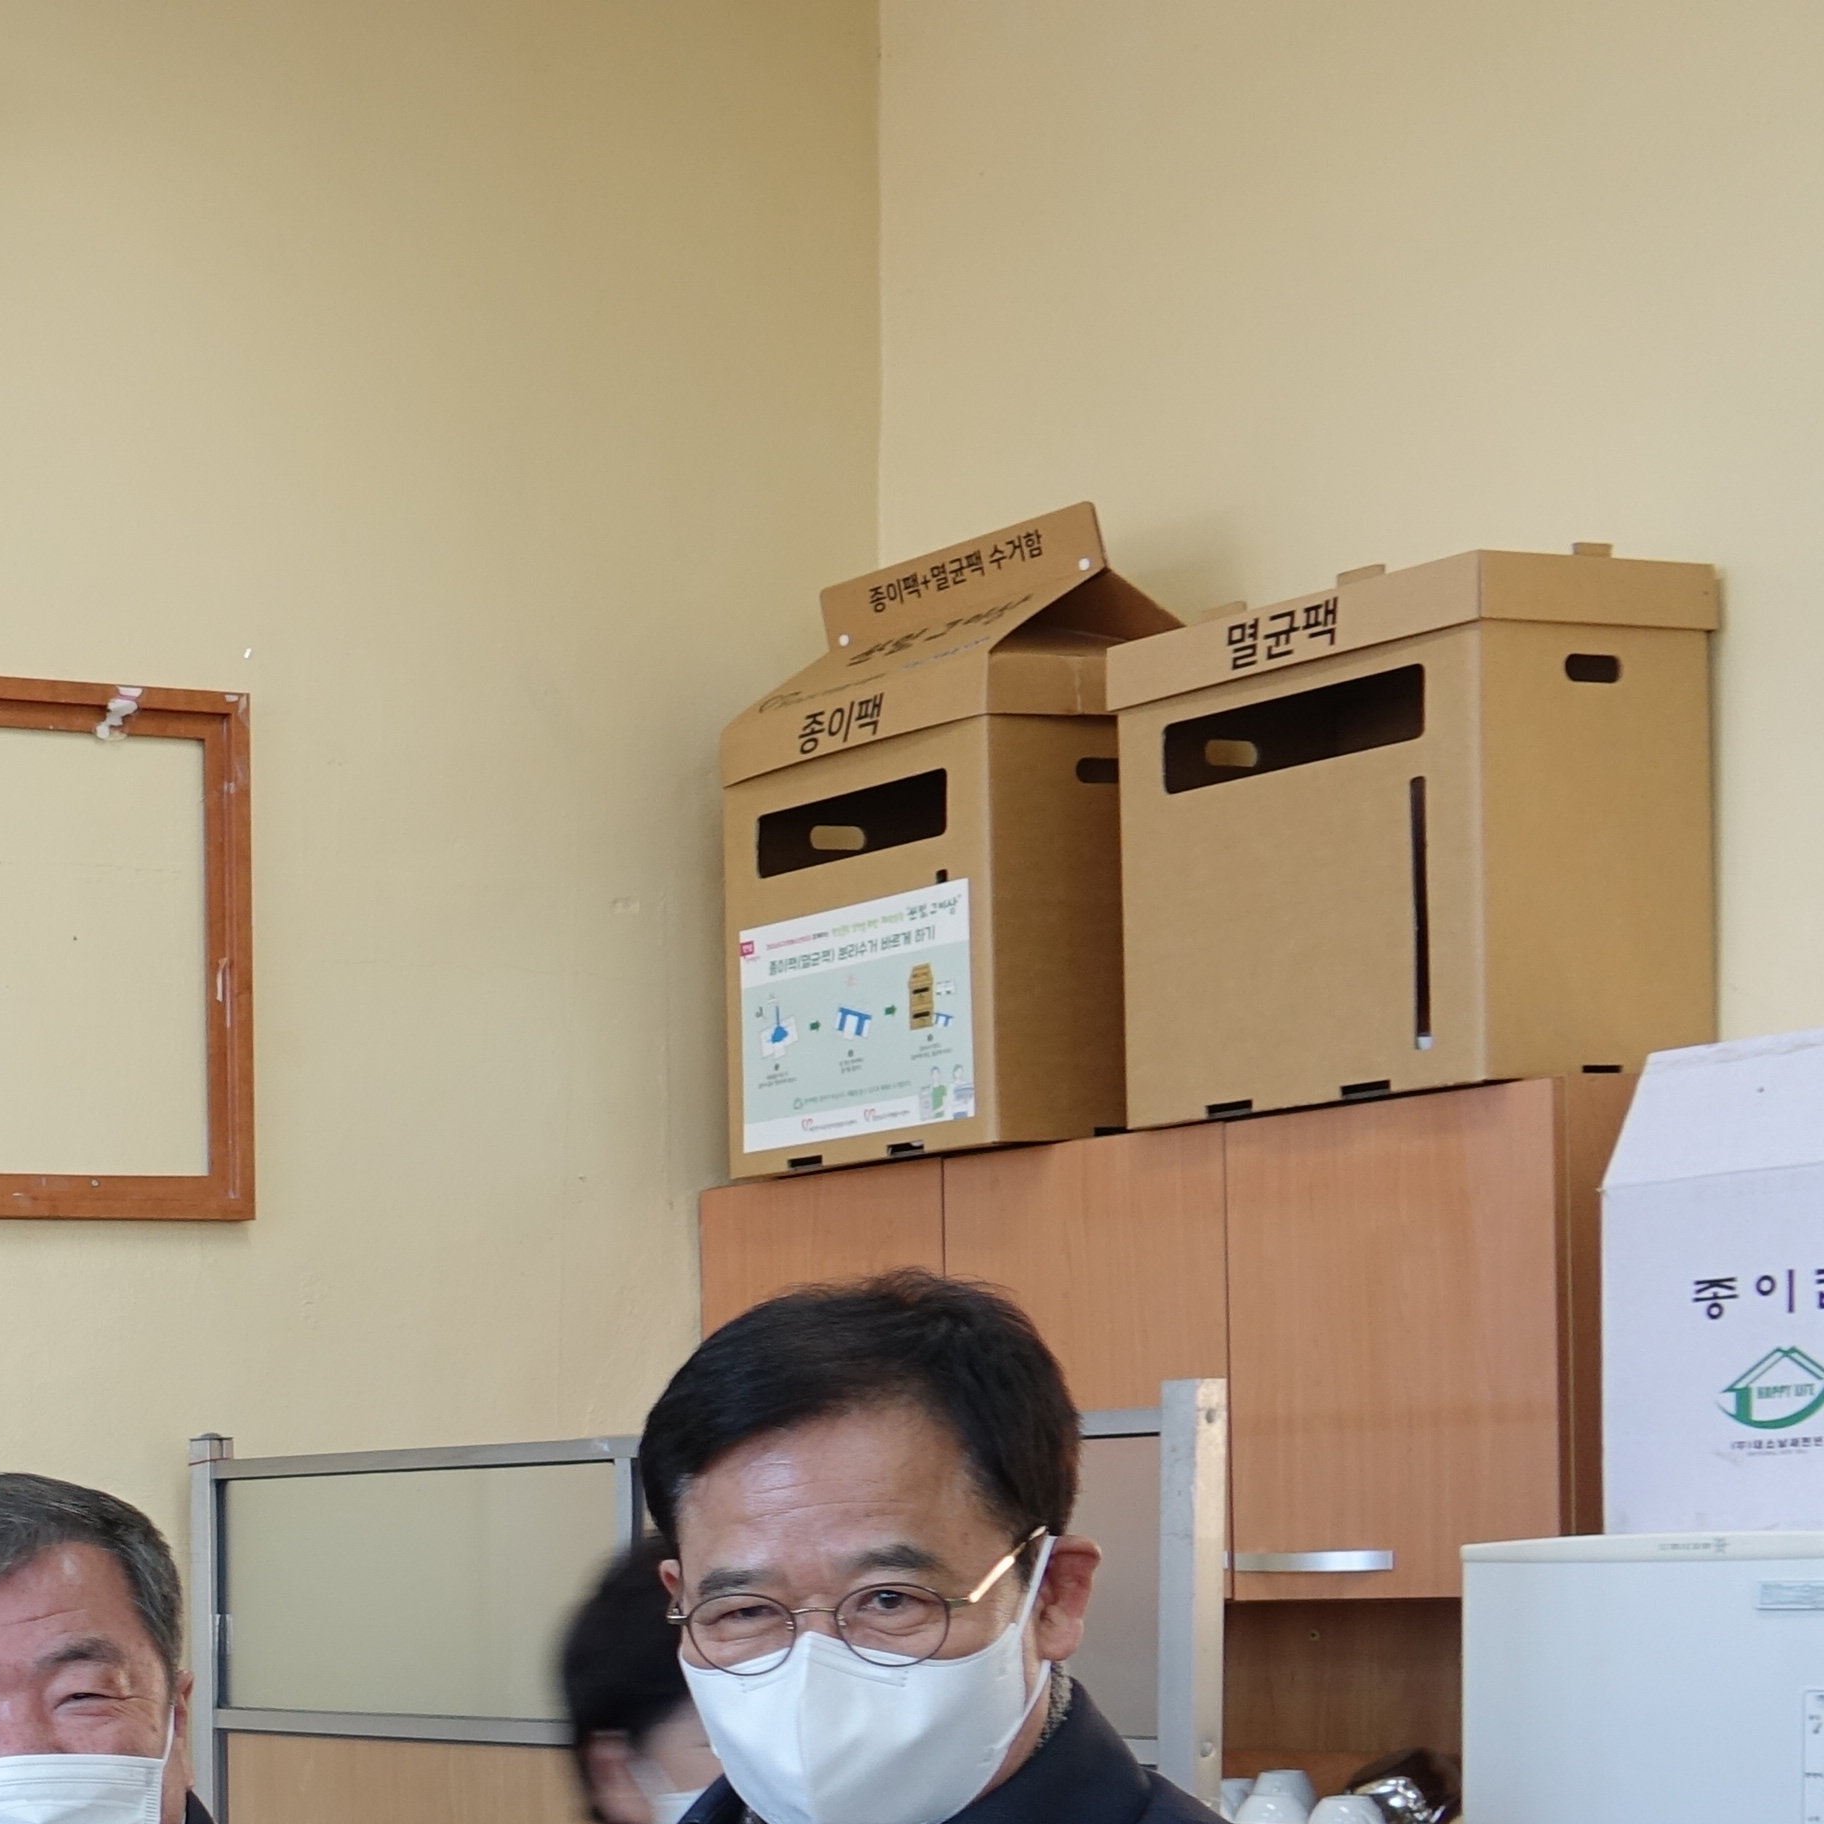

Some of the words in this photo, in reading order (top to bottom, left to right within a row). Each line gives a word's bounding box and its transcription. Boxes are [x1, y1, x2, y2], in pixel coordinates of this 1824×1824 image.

[868, 550, 986, 613] 종이팩+멸균팩
[989, 529, 1044, 570] 수거함
[1227, 596, 1339, 671] 멸균팩
[798, 693, 884, 755] 종이팩
